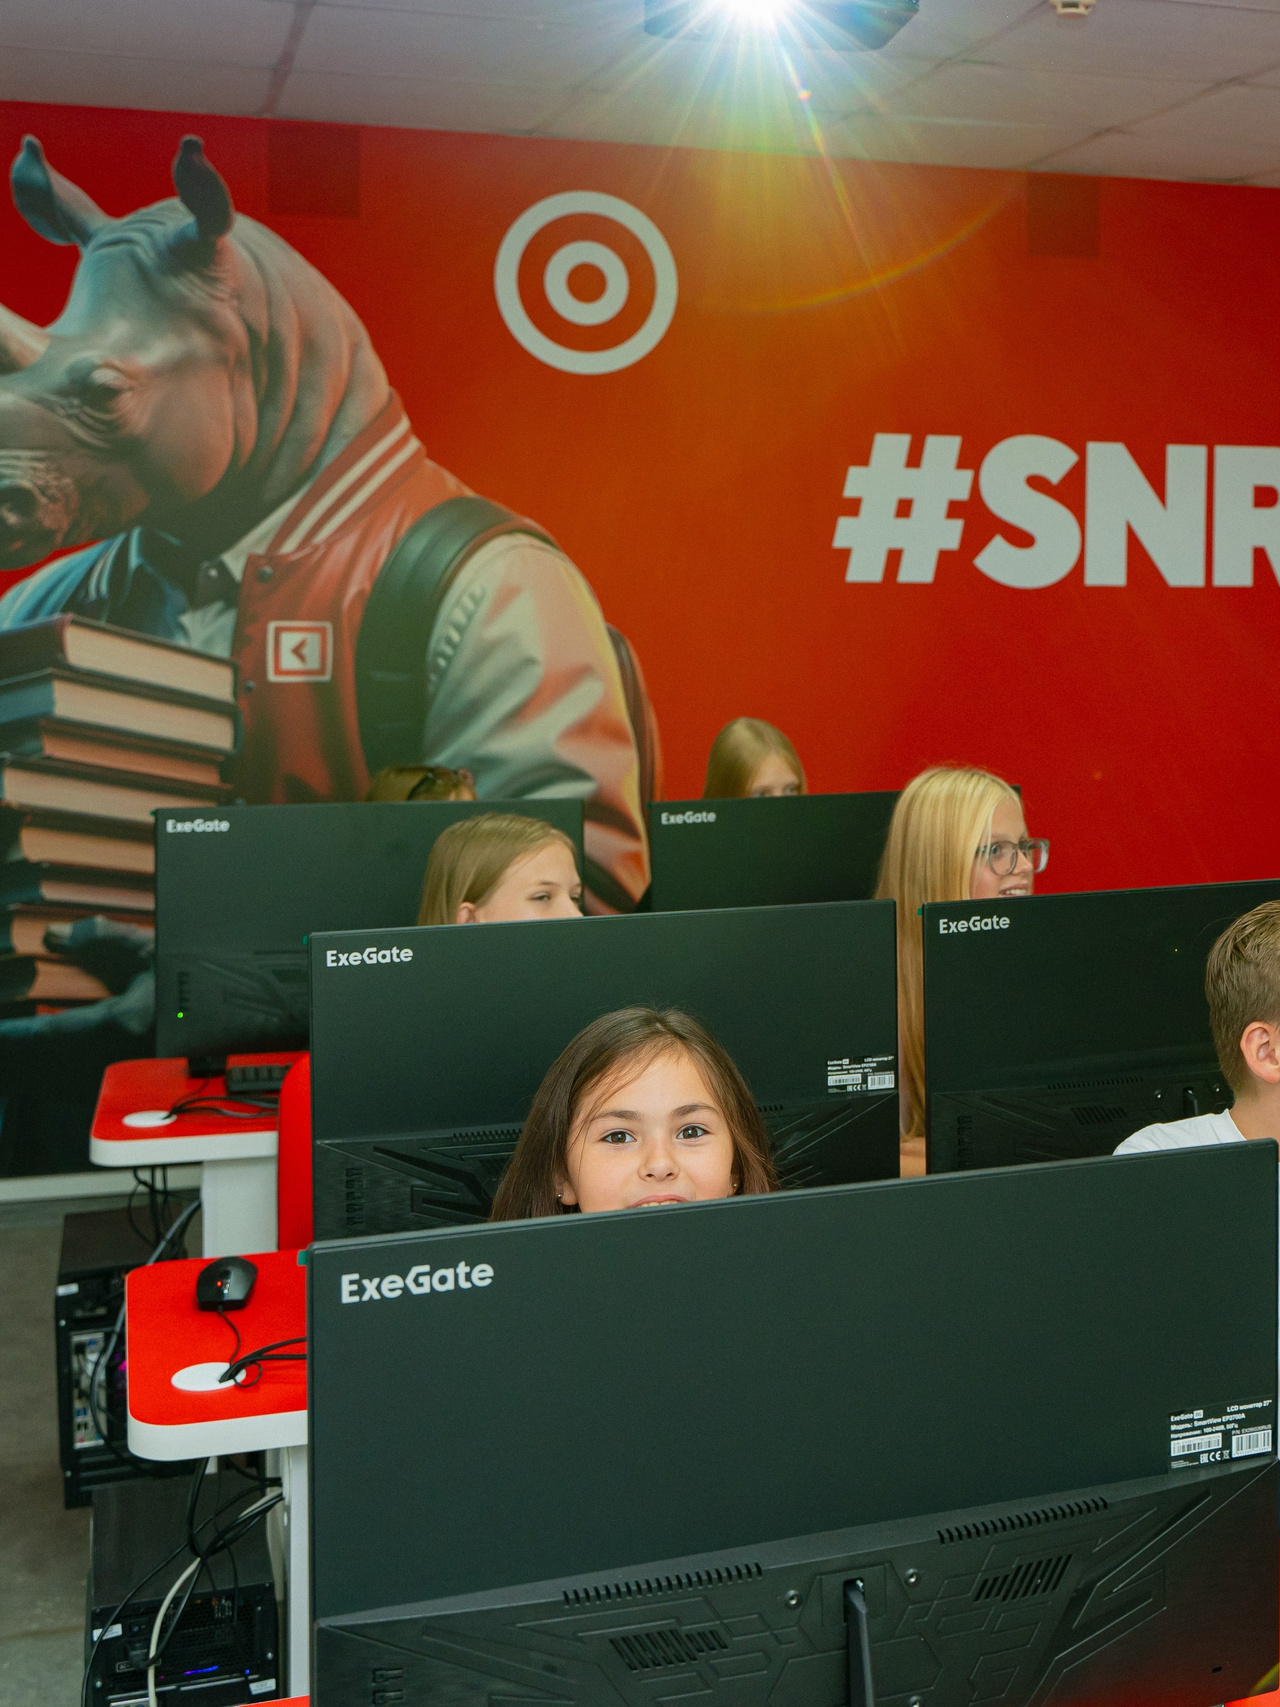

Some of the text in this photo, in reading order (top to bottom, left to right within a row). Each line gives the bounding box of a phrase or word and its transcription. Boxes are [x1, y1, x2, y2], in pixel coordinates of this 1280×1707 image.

[166, 818, 231, 834] ExeGate
[660, 810, 717, 825] ExeGate
[938, 914, 1011, 935] ExeGate
[326, 946, 414, 968] ExeGate
[340, 1260, 495, 1304] ExeGate
